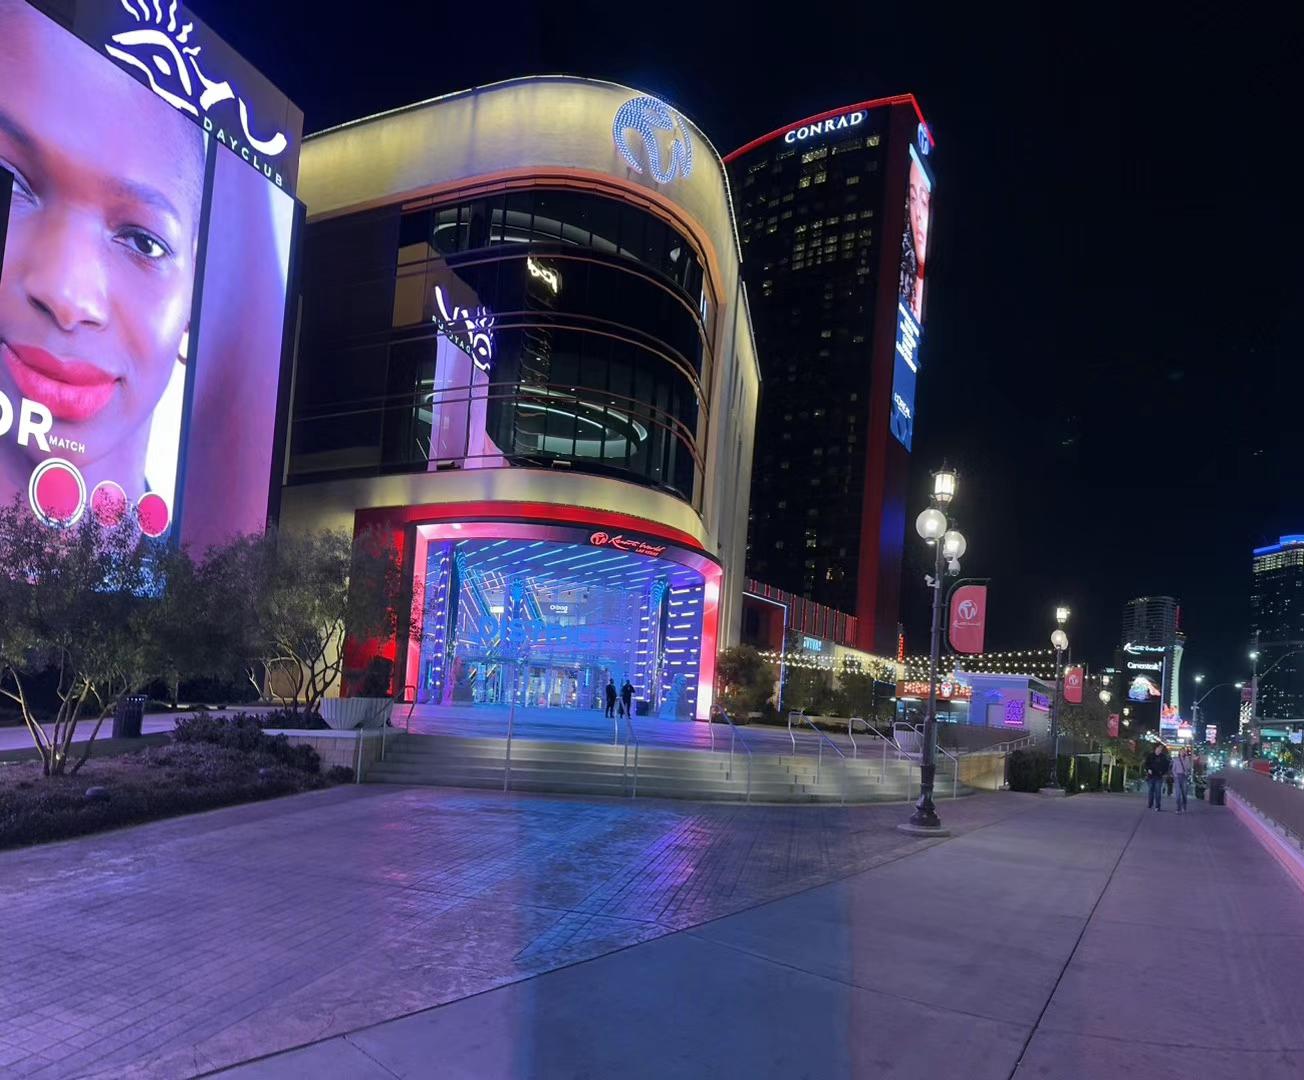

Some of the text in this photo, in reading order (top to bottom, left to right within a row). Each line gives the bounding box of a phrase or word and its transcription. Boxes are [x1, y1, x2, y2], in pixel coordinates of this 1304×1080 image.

[784, 111, 863, 143] CONRAD
[203, 117, 283, 187] DAYCLUB
[49, 434, 86, 454] MATCH
